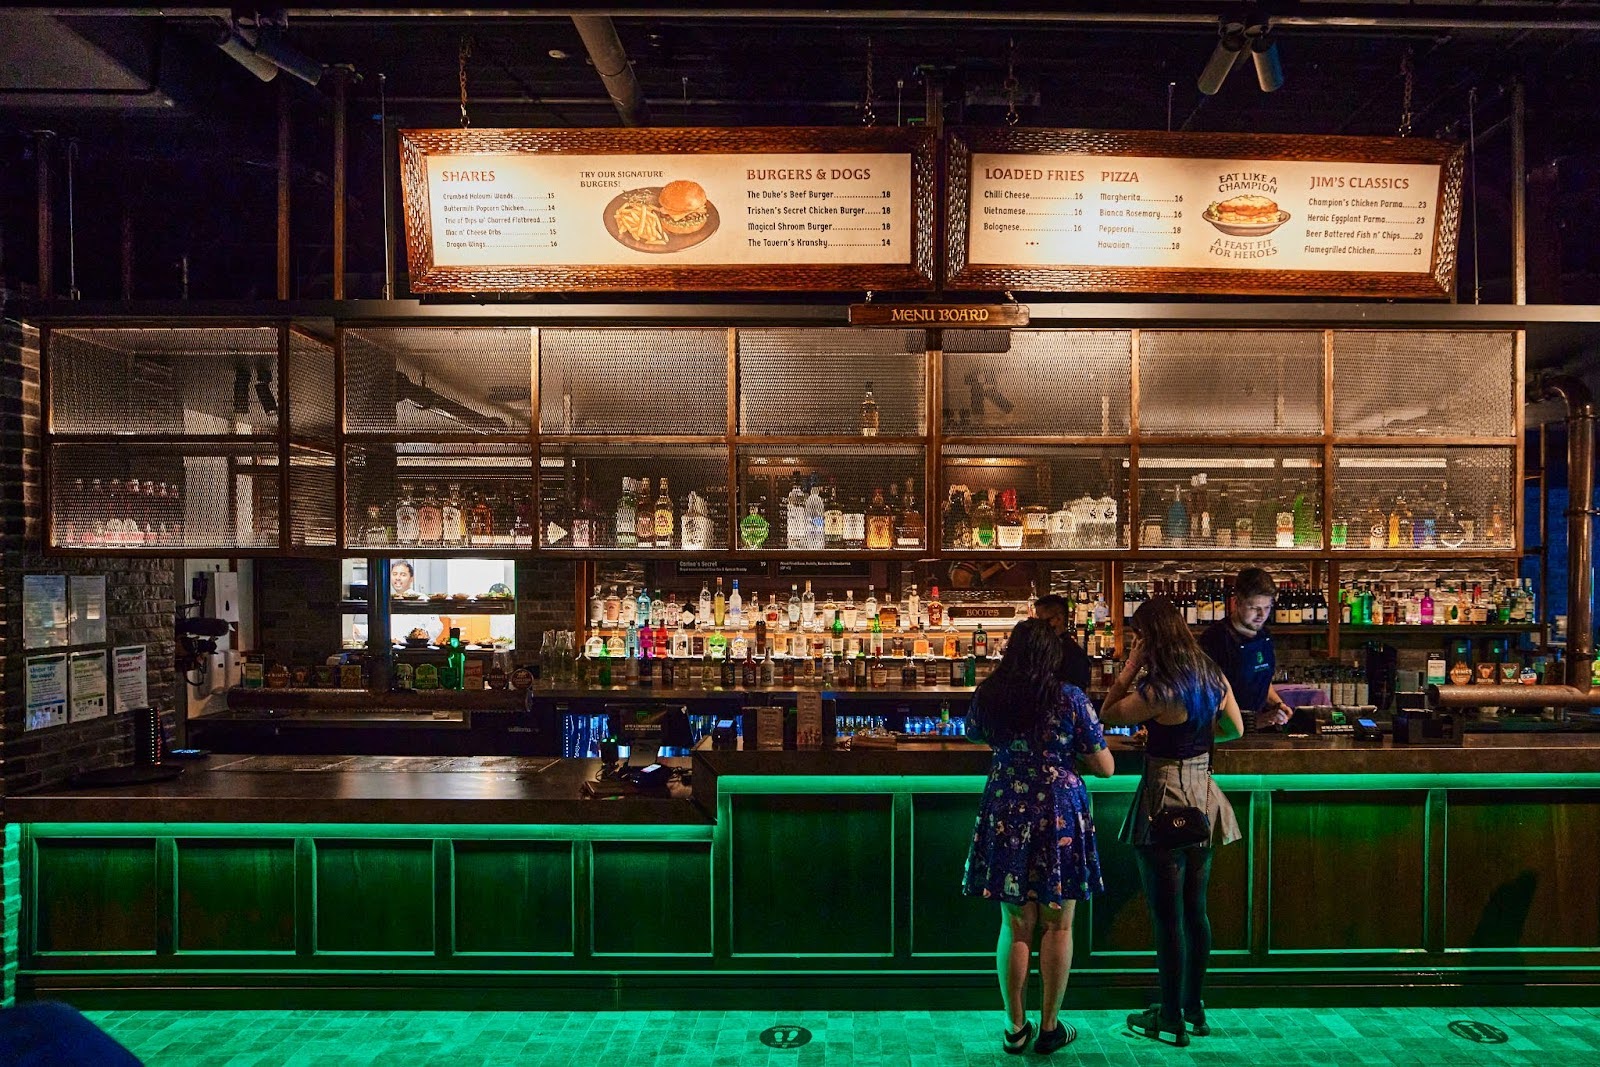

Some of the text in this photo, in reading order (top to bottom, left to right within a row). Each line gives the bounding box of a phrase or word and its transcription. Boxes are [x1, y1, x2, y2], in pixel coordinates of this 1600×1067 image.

[442, 171, 495, 182] SHARES
[747, 169, 871, 180] BURGERS & DOGS
[986, 168, 1084, 182] LOADED FRIES
[1101, 171, 1139, 182] PIZZA
[1219, 173, 1277, 185] EAT LIKE A
[1310, 176, 1409, 189] JIM'S CLASSICS
[1218, 182, 1278, 194] CHAMPION
[809, 191, 834, 200] Burger
[1005, 191, 1030, 199] Cheese
[1100, 193, 1141, 202] Margherita
[1309, 198, 1349, 208] Champion's
[1351, 199, 1378, 207] Chicken
[840, 207, 865, 216] Burger
[984, 207, 1026, 215] Vietnamese
[1100, 209, 1123, 217] Bianca
[1126, 209, 1161, 220] Rosemary
[1332, 215, 1361, 224] Eggplant
[748, 223, 775, 232] Magical
[808, 223, 832, 232] Burger
[984, 223, 1020, 232] Bolognese
[1099, 225, 1135, 234] Pepperoni
[1382, 231, 1400, 241] Chips
[797, 239, 828, 248] Kransky
[1214, 238, 1272, 250] A FEAST FIT
[1209, 246, 1278, 259] FOR HEROES
[1304, 246, 1346, 255] Flamegrilled
[891, 309, 988, 322] MENU BOARD
